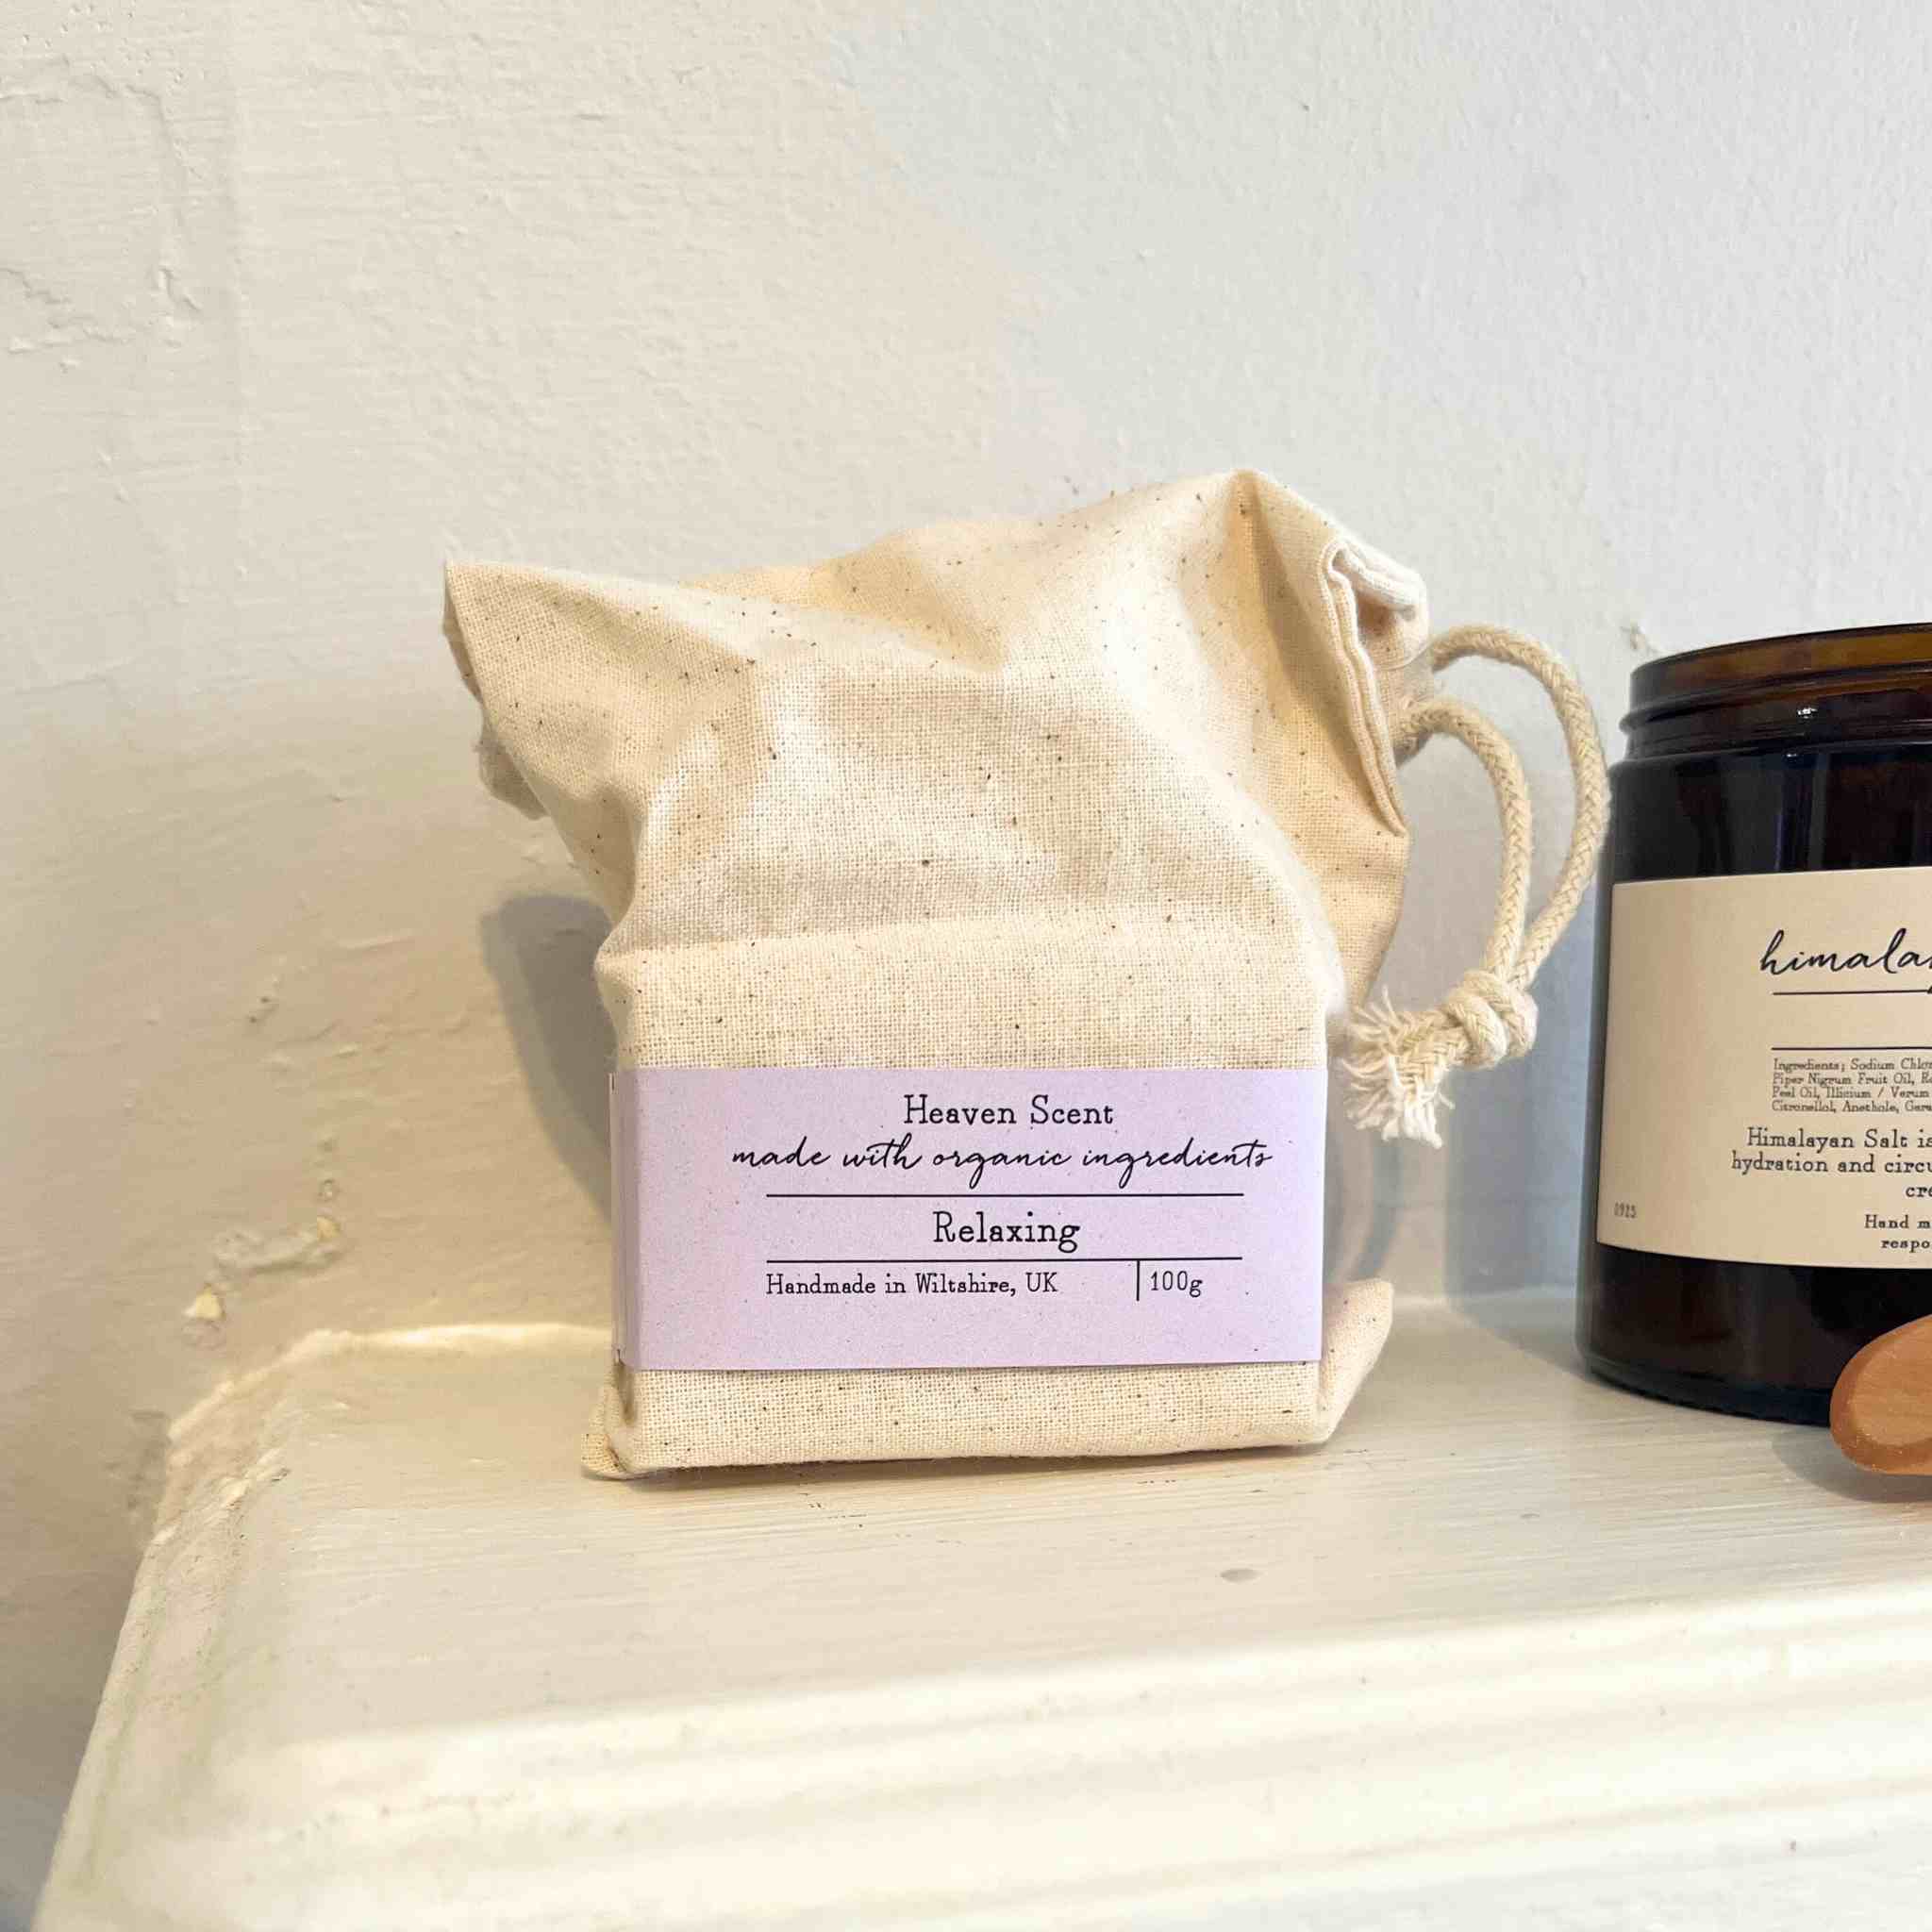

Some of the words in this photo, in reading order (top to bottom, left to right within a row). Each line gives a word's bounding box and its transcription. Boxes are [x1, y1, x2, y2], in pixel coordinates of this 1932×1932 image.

[1759, 927, 1932, 993] himala
[1850, 1058, 1895, 1070] Sodium
[1772, 1086, 1795, 1098] Peel
[1799, 1086, 1821, 1100] Oil,
[1890, 1086, 1930, 1098] Verum
[1773, 1072, 1805, 1088] Piper
[1807, 1072, 1852, 1088] Nigrum
[1857, 1072, 1888, 1085] Fruit
[1893, 1072, 1915, 1086] Oil,
[903, 1093, 1018, 1126] Heaven
[1030, 1093, 1114, 1126] Scent
[1772, 1100, 1837, 1113] Citronellol,
[1842, 1100, 1899, 1114] Anethole,
[1747, 1126, 1855, 1154] Himalayan
[1864, 1128, 1907, 1148] Salt
[731, 1135, 831, 1170] made
[841, 1131, 924, 1171] with
[932, 1148, 1073, 1191] organic
[1081, 1137, 1274, 1190] ingredients
[1731, 1150, 1829, 1175] hydration
[1837, 1153, 1875, 1173] and
[931, 1209, 1081, 1255] Relaxing
[1864, 1213, 1909, 1229] Hand
[1880, 1240, 1931, 1254] respo
[765, 1272, 876, 1295] Handmade
[884, 1272, 907, 1294] in
[914, 1272, 1018, 1299] Wiltshire,
[1024, 1272, 1059, 1293] UK
[1150, 1271, 1204, 1299] 100g
